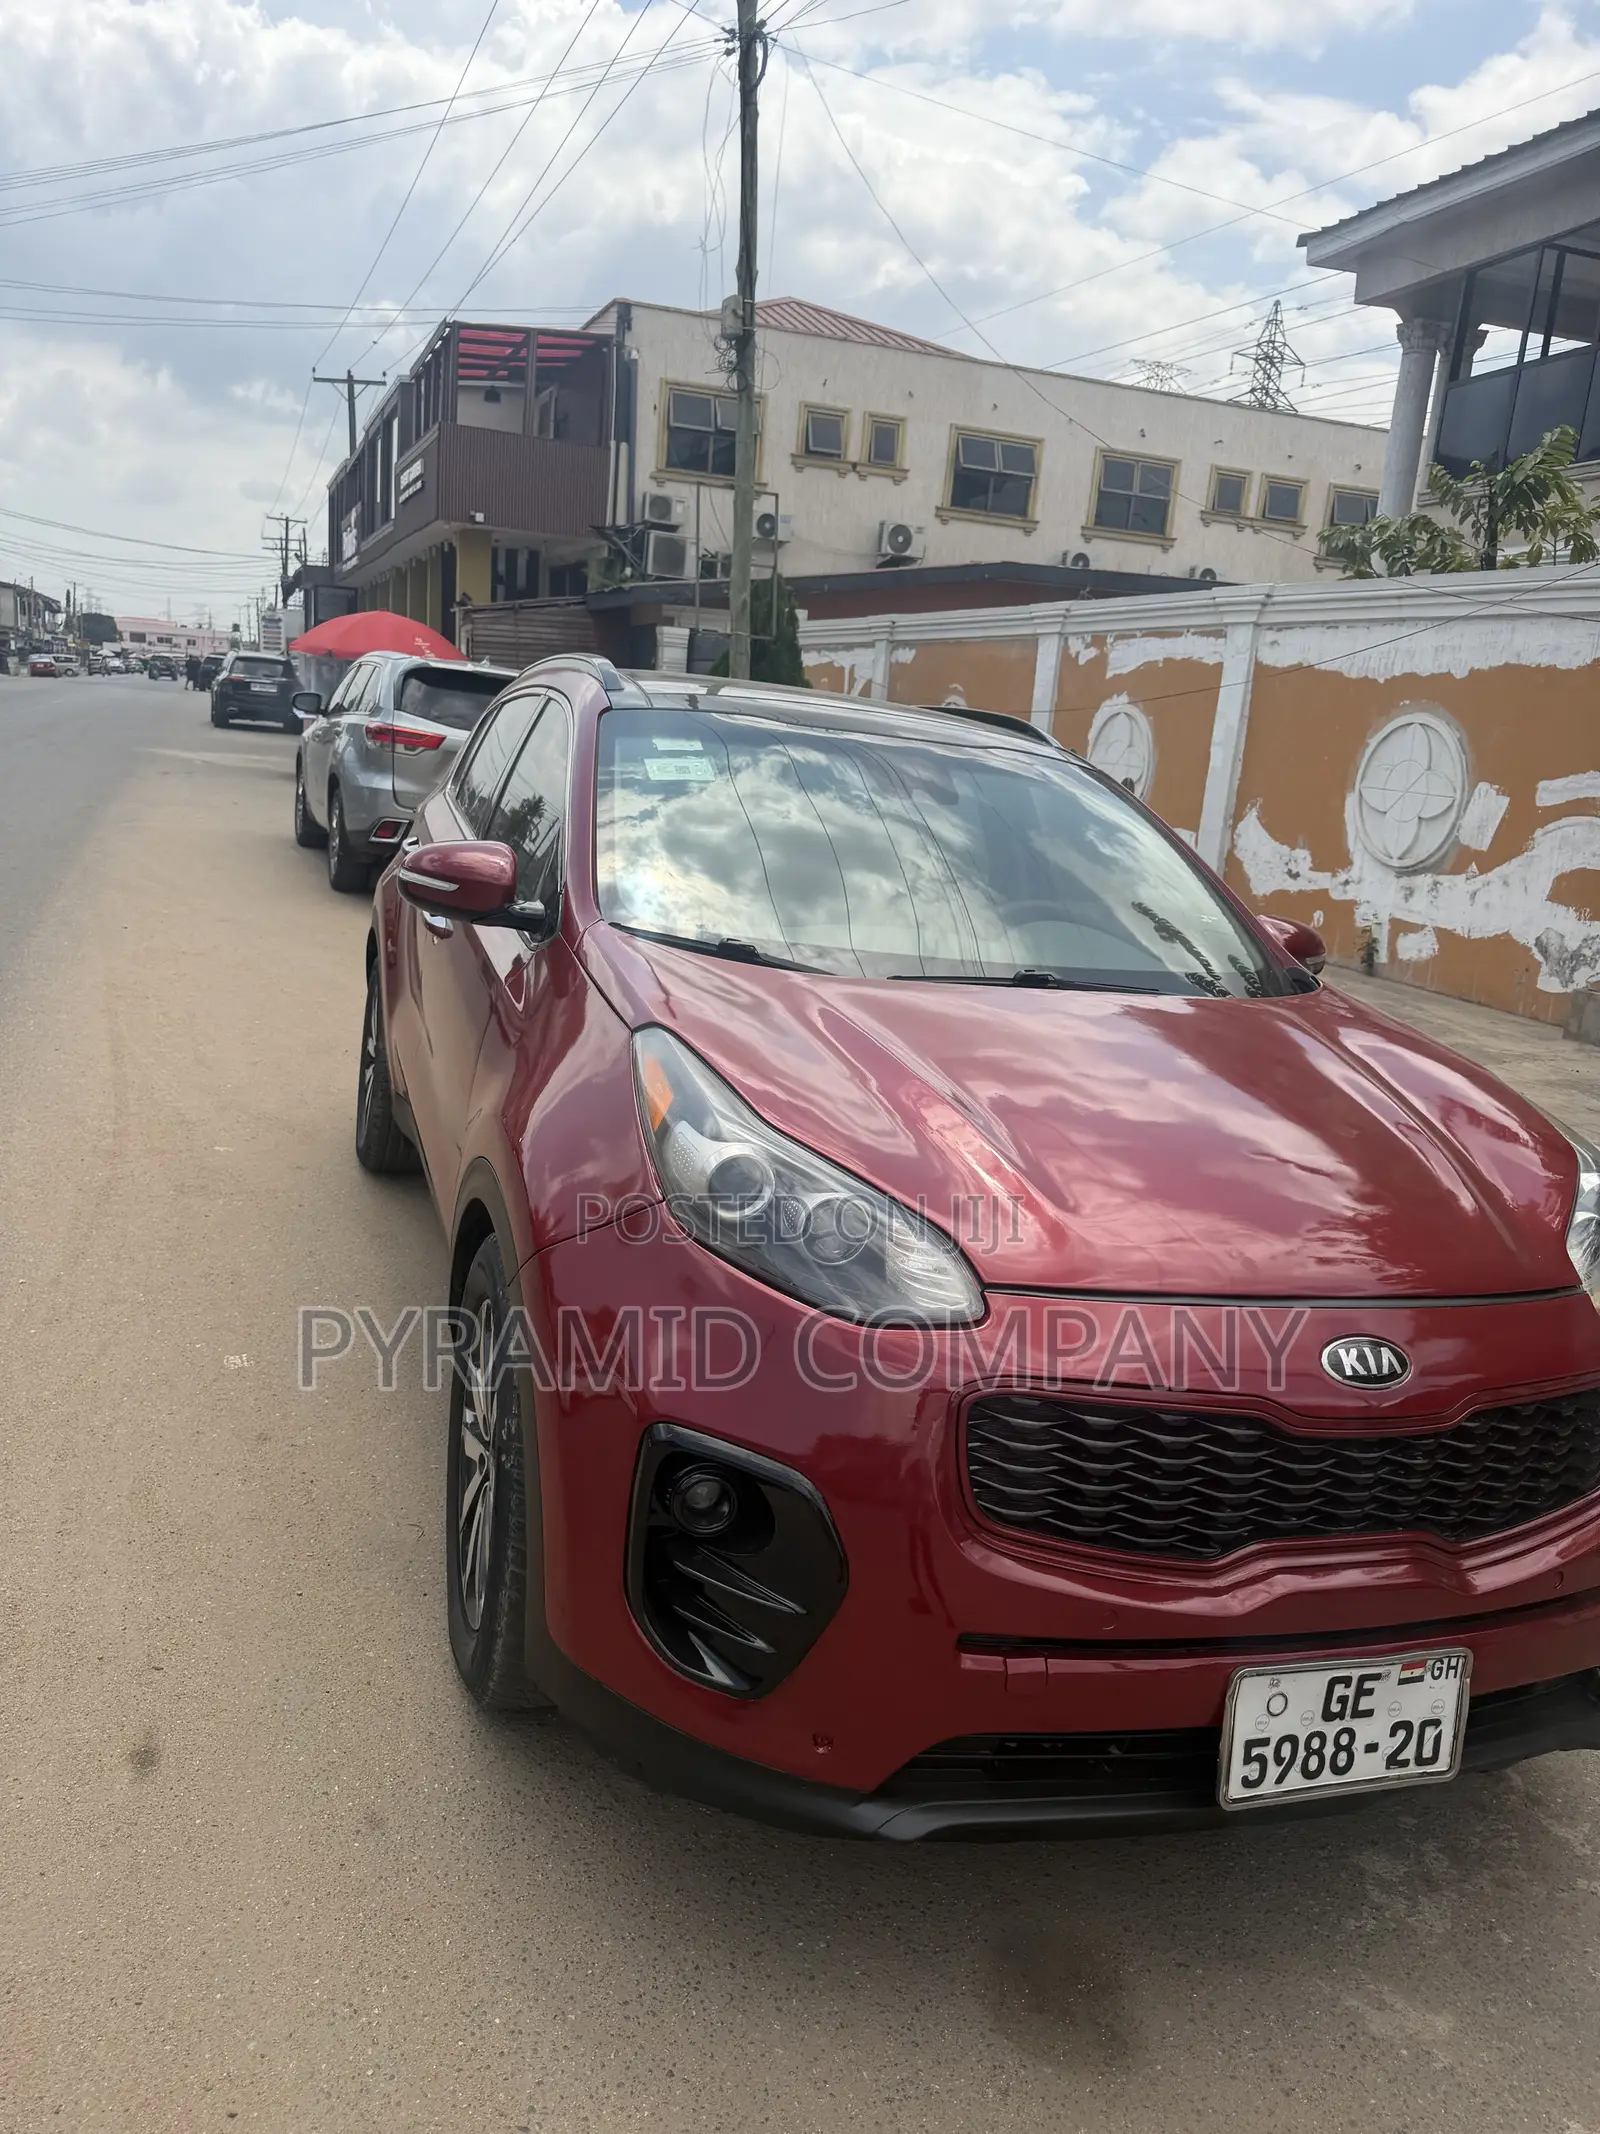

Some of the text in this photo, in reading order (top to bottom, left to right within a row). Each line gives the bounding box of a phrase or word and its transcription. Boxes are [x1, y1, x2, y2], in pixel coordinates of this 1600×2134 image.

[1337, 1346, 1403, 1376] KIA
[1430, 1657, 1460, 1681] GH
[1322, 1672, 1383, 1722] GE
[1240, 1717, 1443, 1789] 5988-20
